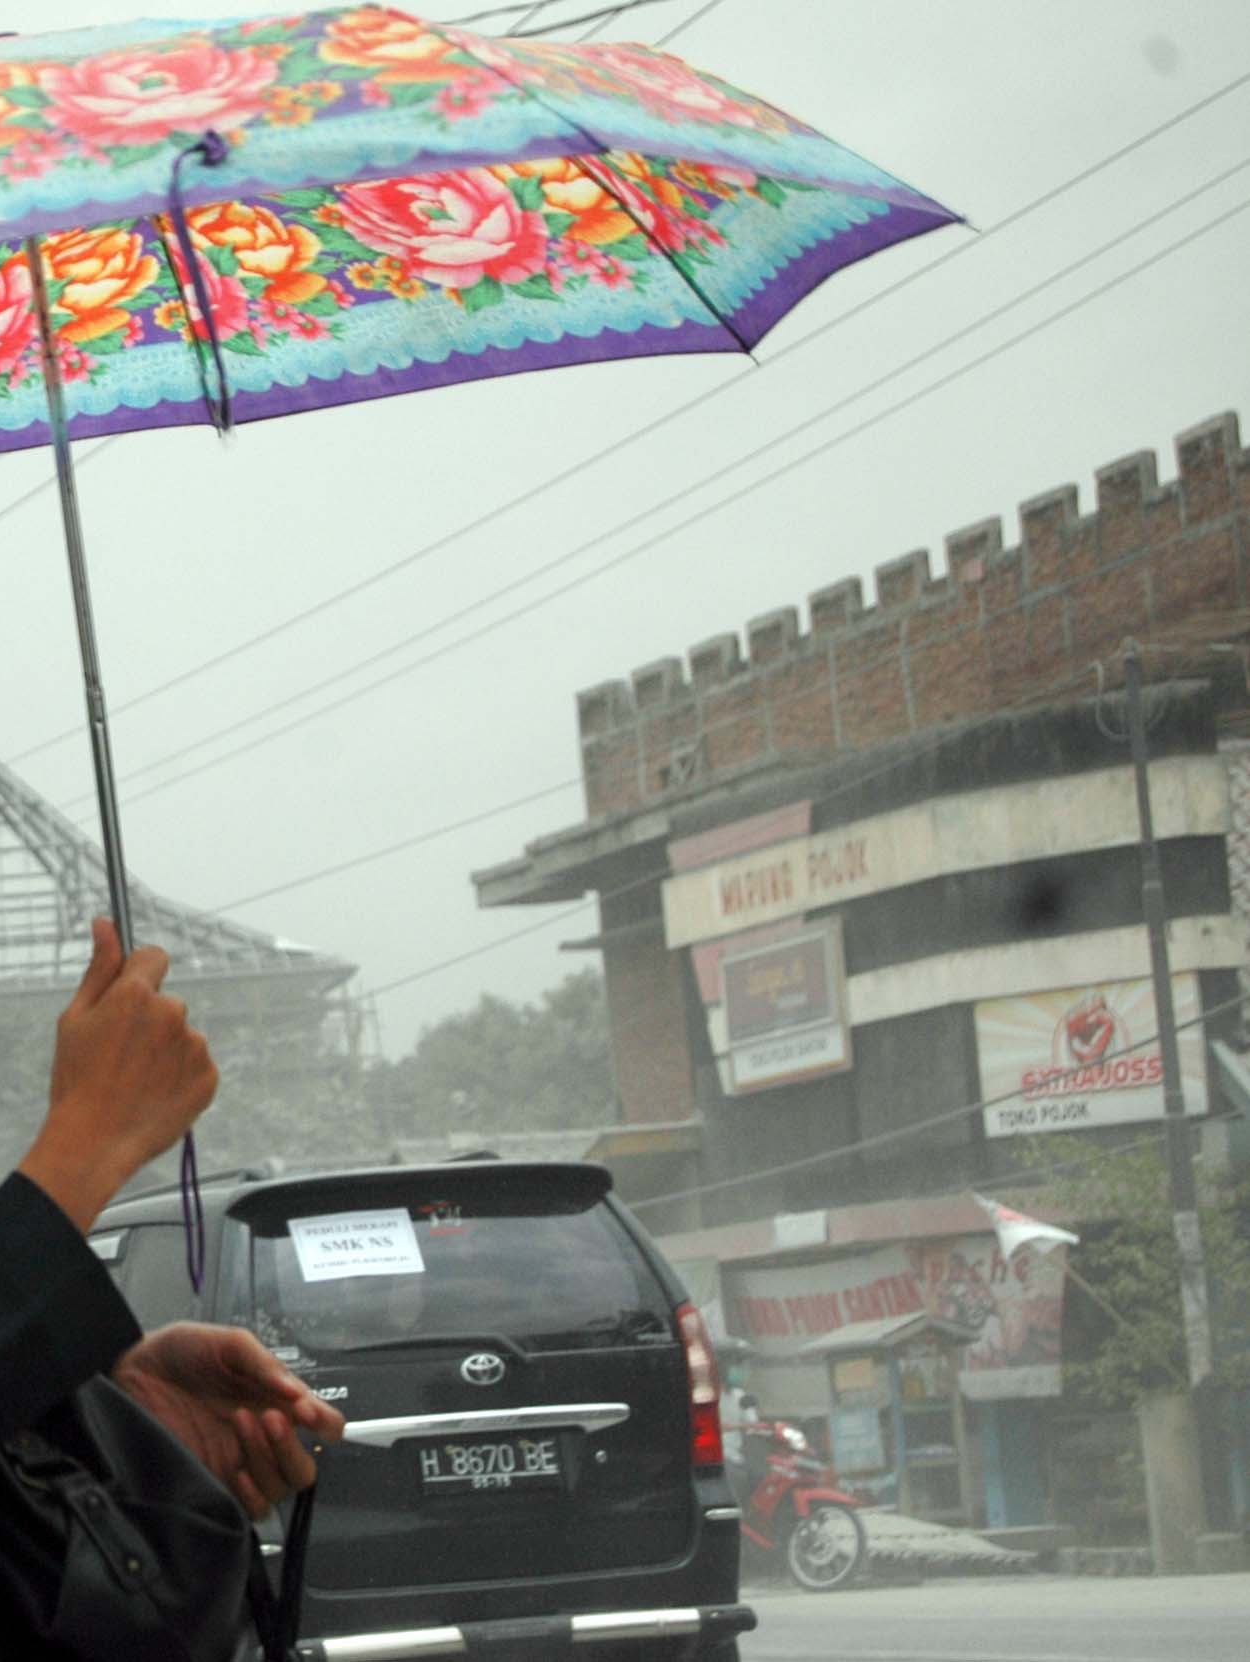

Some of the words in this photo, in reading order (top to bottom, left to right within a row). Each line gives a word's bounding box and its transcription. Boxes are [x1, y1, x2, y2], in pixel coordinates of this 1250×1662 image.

[719, 858, 794, 916] WARUNG
[807, 838, 868, 895] POJOK
[1102, 1056, 1163, 1087] JOSS
[1040, 1102, 1089, 1123] POJOK
[320, 1237, 364, 1252] SMK
[420, 1448, 440, 1476] H
[451, 1443, 516, 1475] 8670
[523, 1440, 558, 1472] BE
